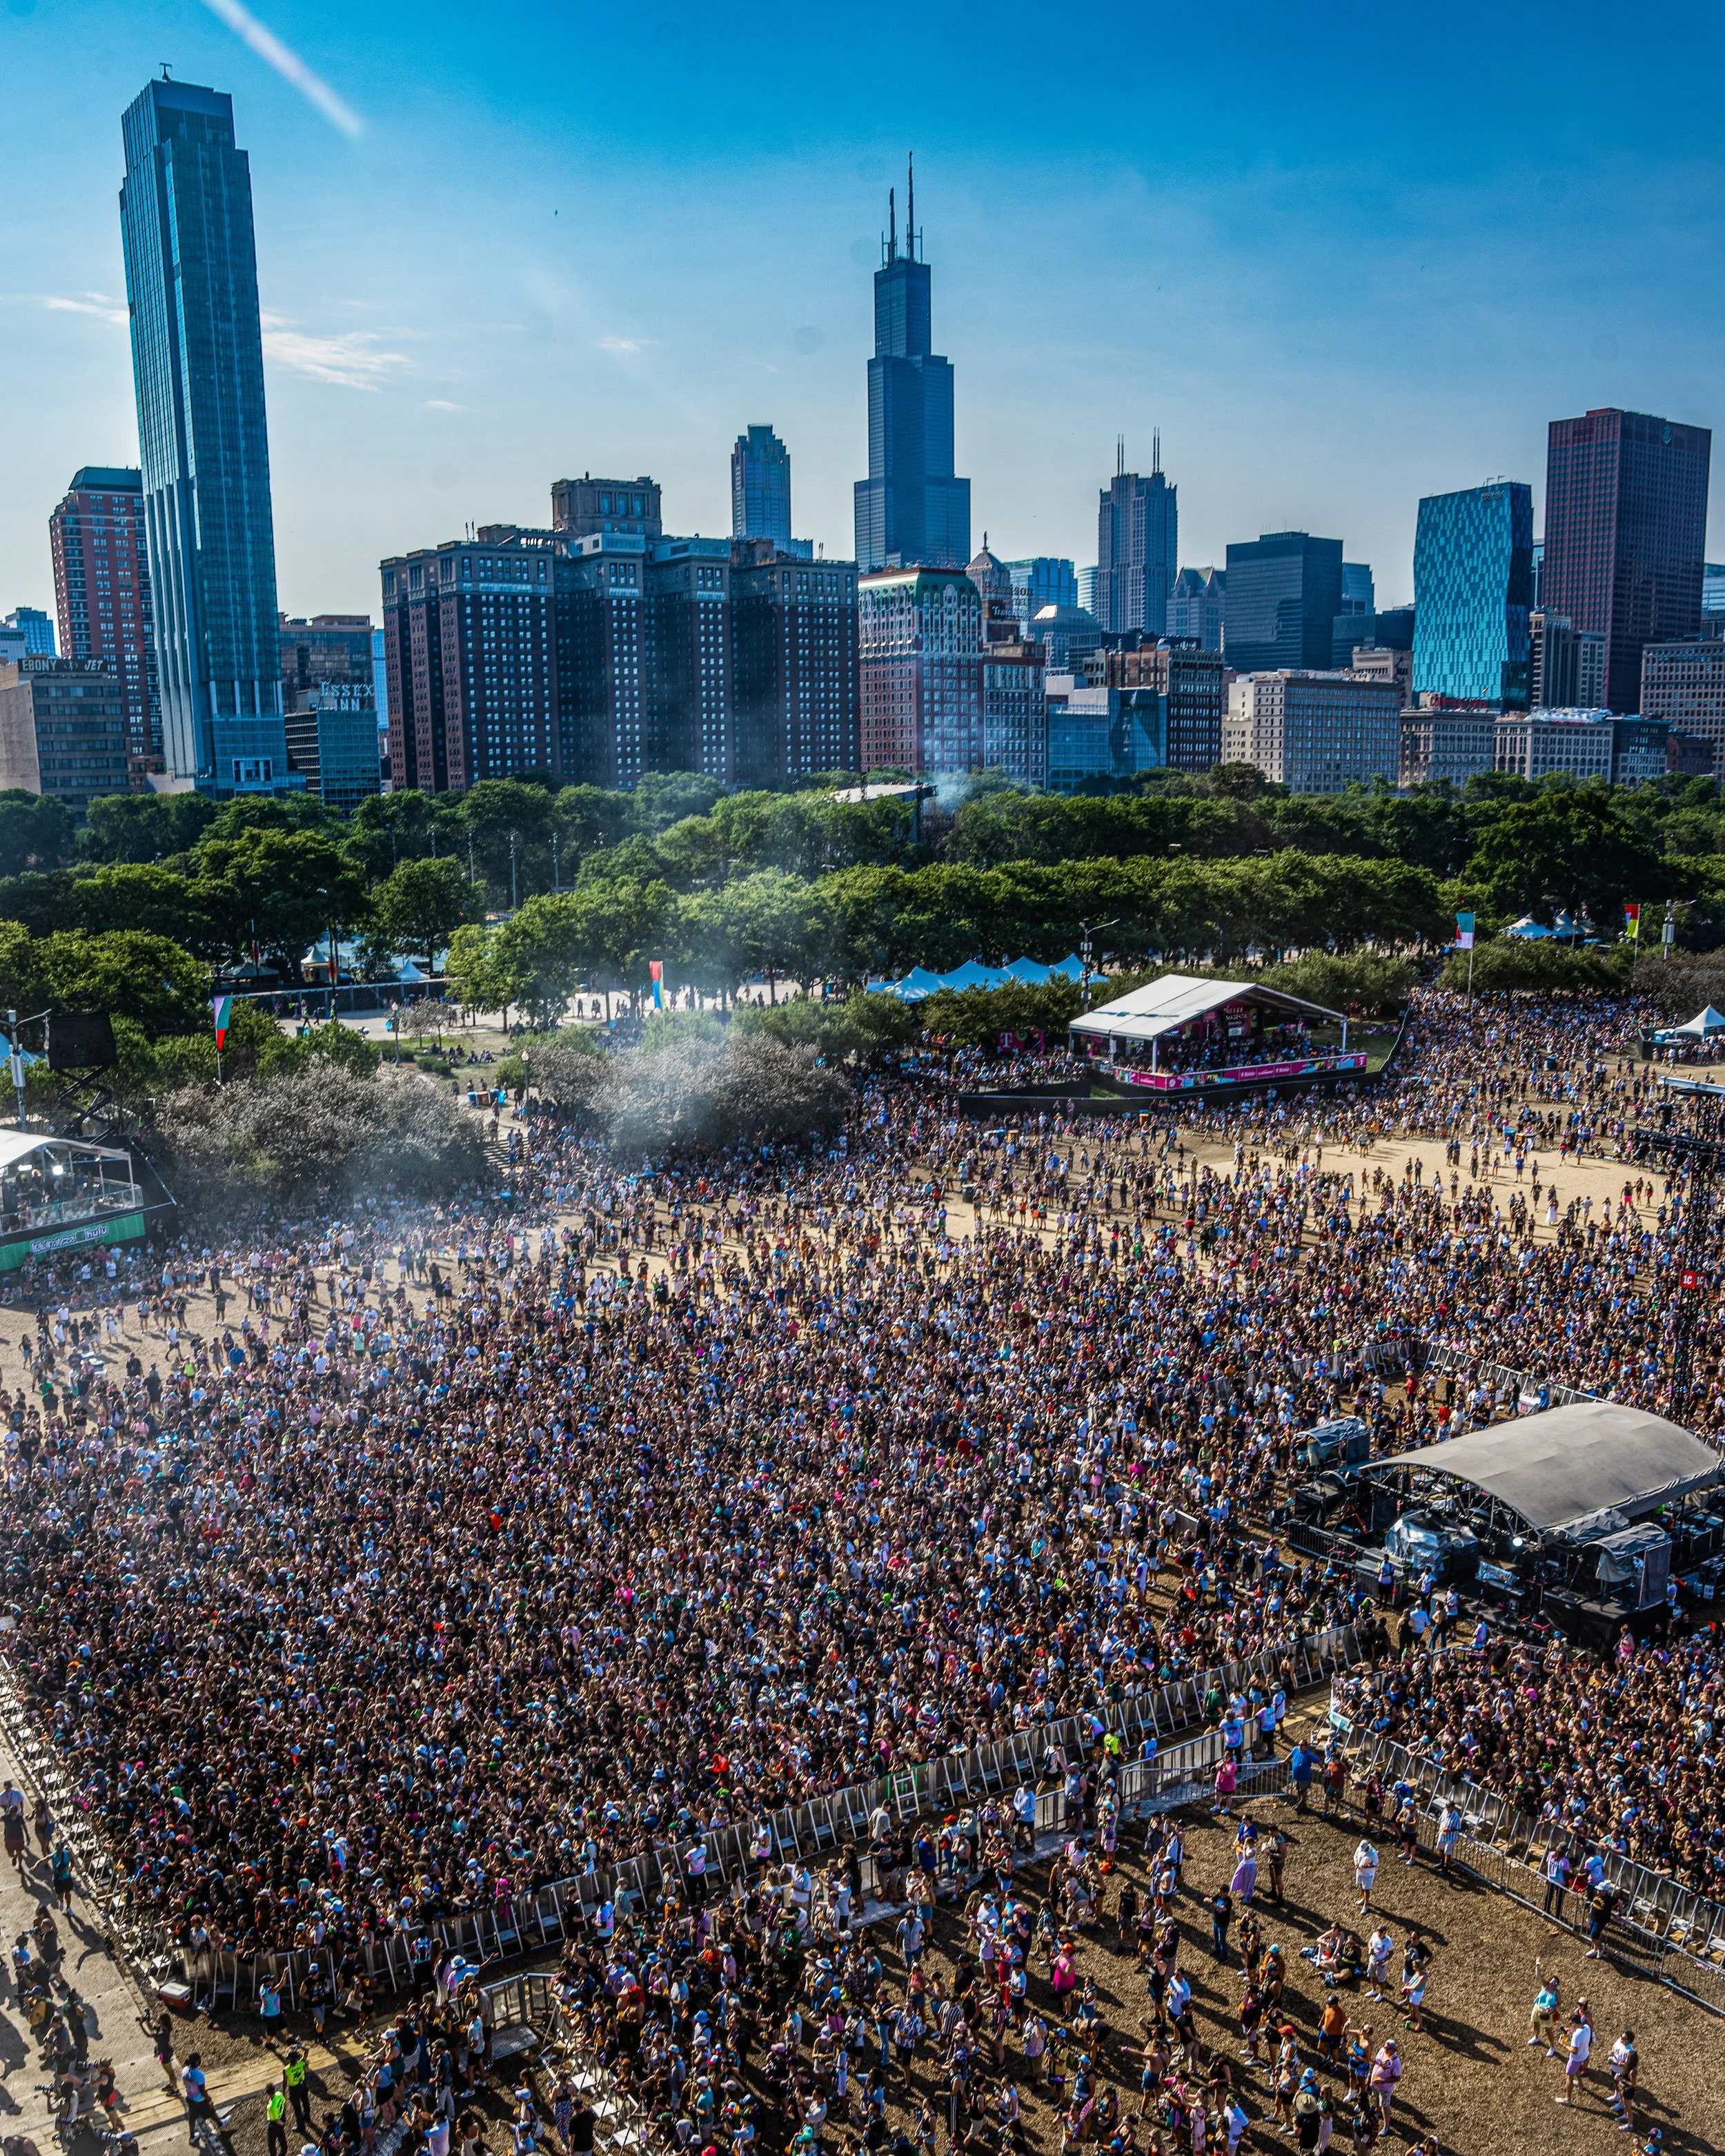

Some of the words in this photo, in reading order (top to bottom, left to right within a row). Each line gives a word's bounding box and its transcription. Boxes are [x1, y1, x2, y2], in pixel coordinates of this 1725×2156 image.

[22, 659, 57, 671] EBONY
[84, 659, 103, 671] JET
[320, 680, 375, 697] ESSEX
[334, 698, 359, 712] INN
[1000, 1032, 1013, 1048] T
[85, 1226, 108, 1240] hulu
